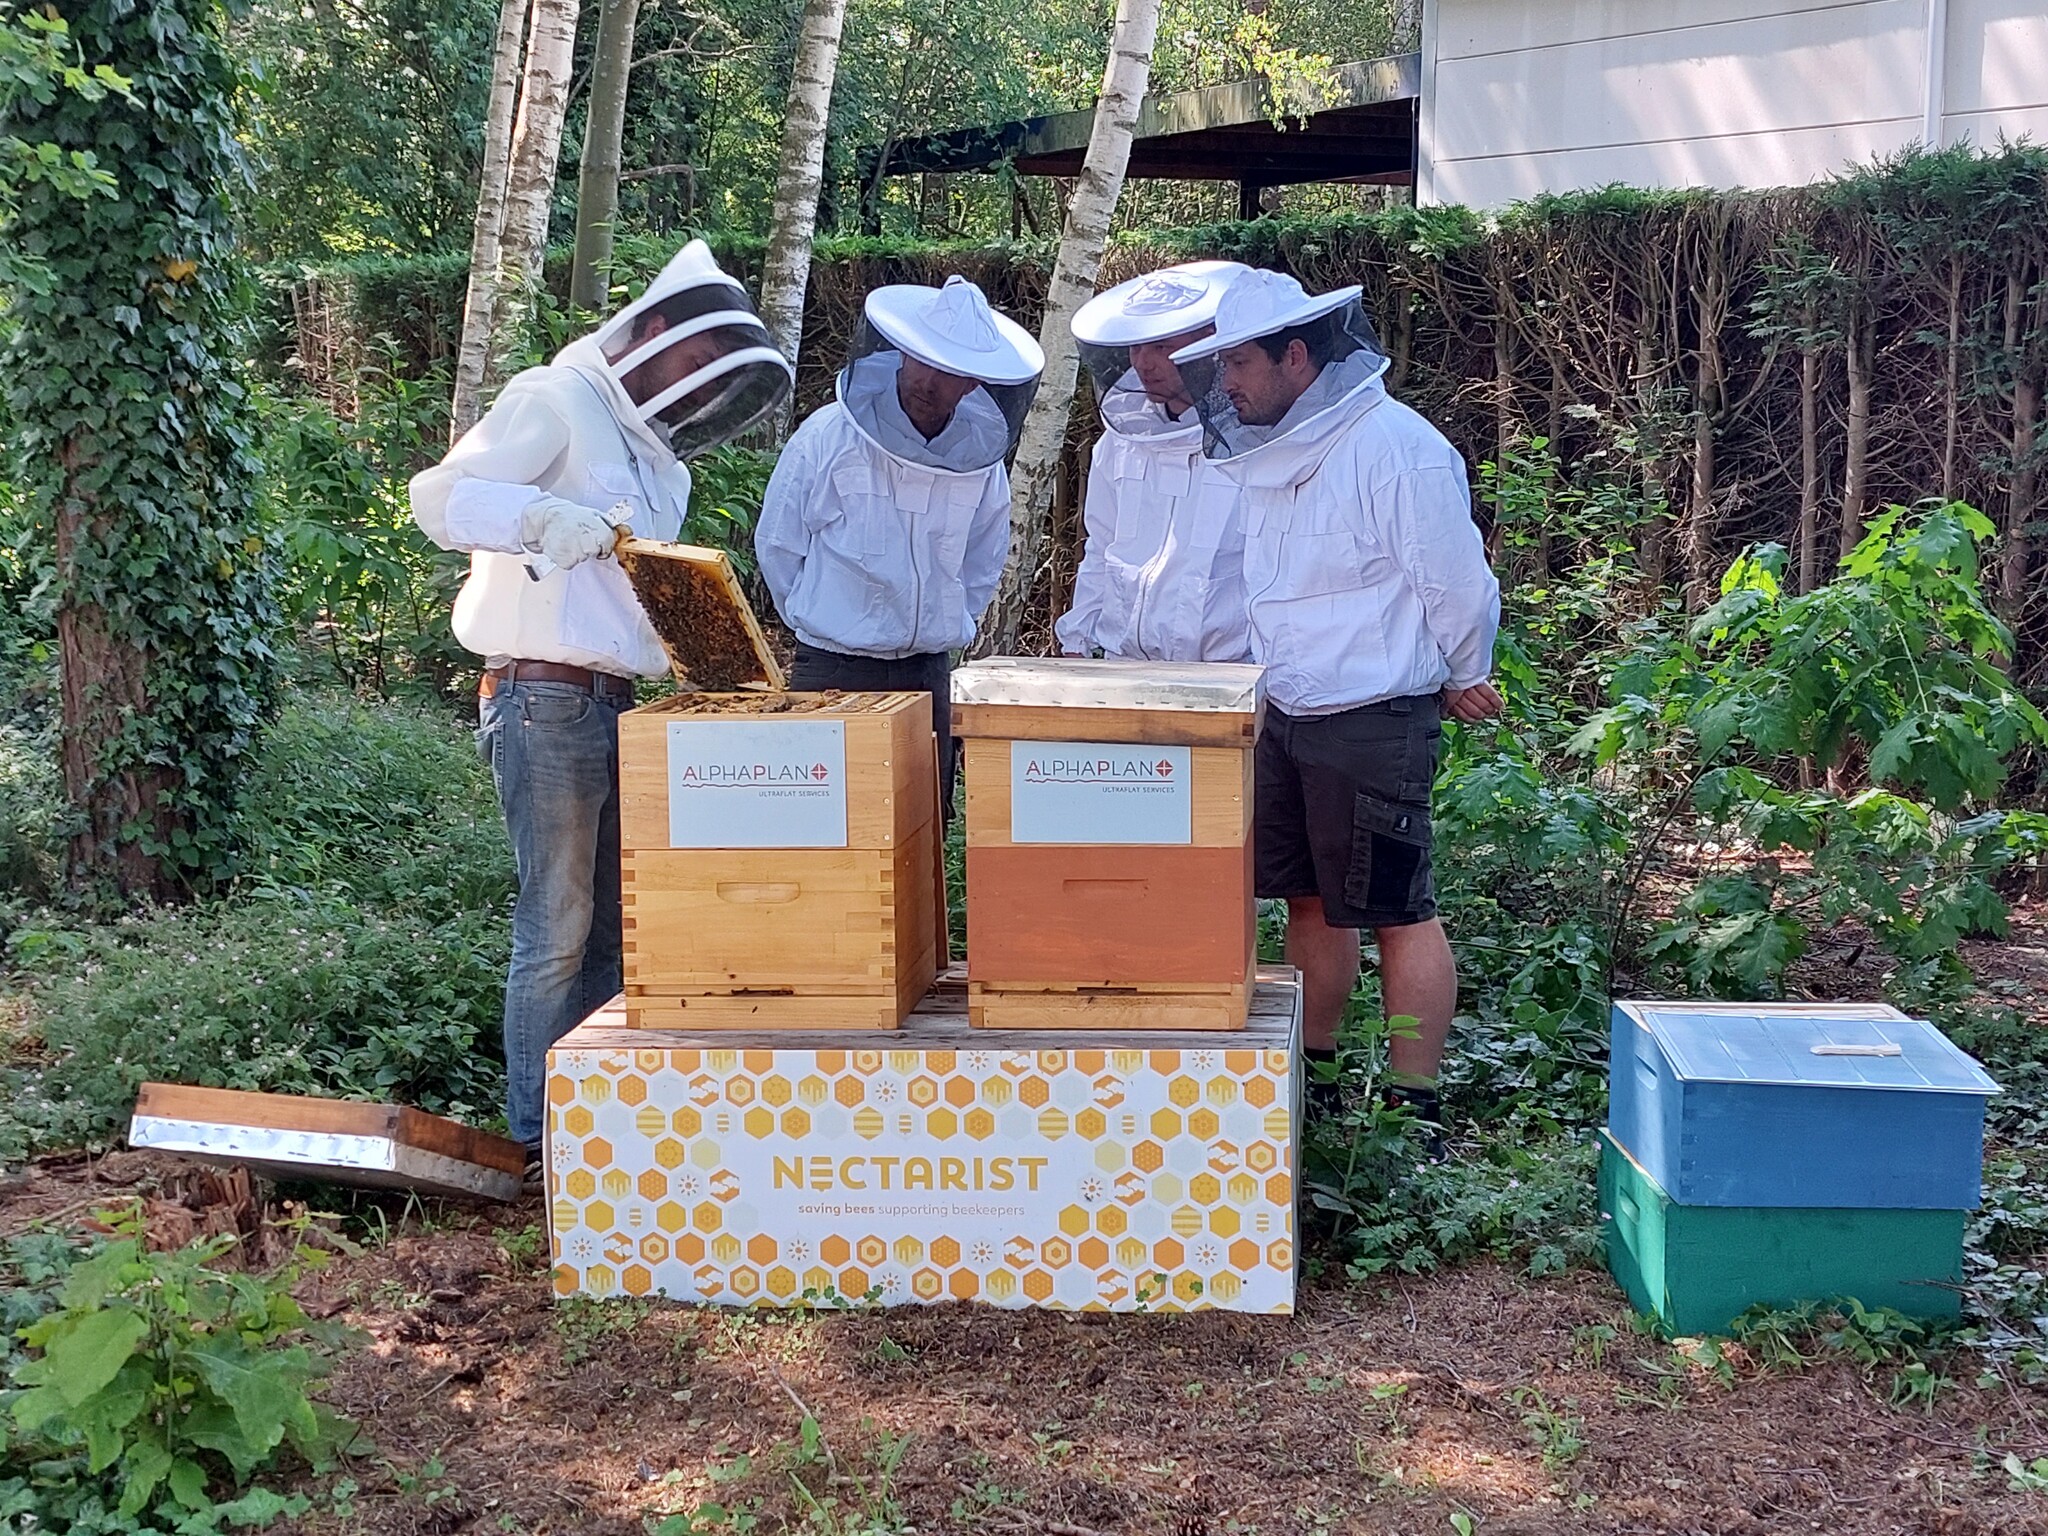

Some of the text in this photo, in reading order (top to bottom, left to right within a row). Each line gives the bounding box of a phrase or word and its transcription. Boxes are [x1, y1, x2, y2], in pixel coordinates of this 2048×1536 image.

[682, 764, 809, 781] ALPHAPLAN
[1025, 760, 1154, 777] ALPHAPLAN
[758, 790, 830, 798] ULTRAFLAT SERVICES
[1102, 786, 1175, 794] ULTRAFLAT SERVICES
[772, 1156, 1049, 1192] NECTARIST
[798, 1202, 1026, 1218] saving bees supporting beekeepers
